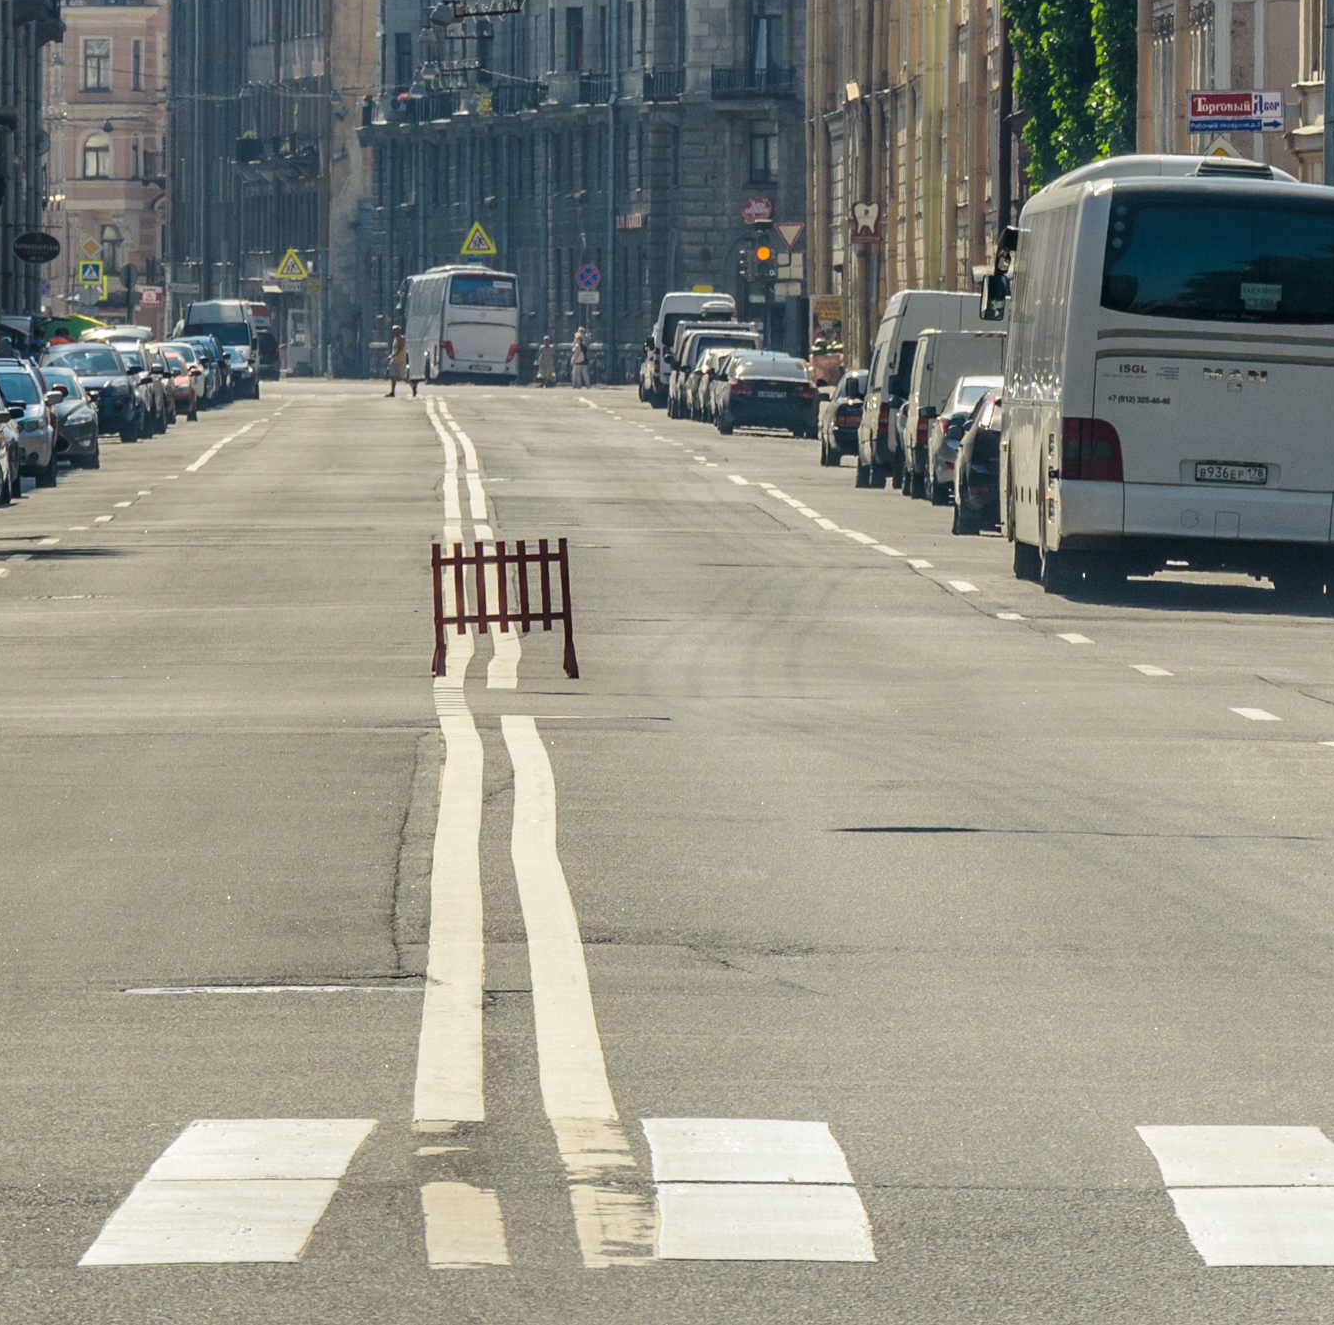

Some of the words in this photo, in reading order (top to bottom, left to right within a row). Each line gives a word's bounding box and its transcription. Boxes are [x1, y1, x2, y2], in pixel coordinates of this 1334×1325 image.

[1193, 96, 1251, 115] Торговый
[1119, 364, 1148, 374] ISGL
[1203, 367, 1268, 383] MAN
